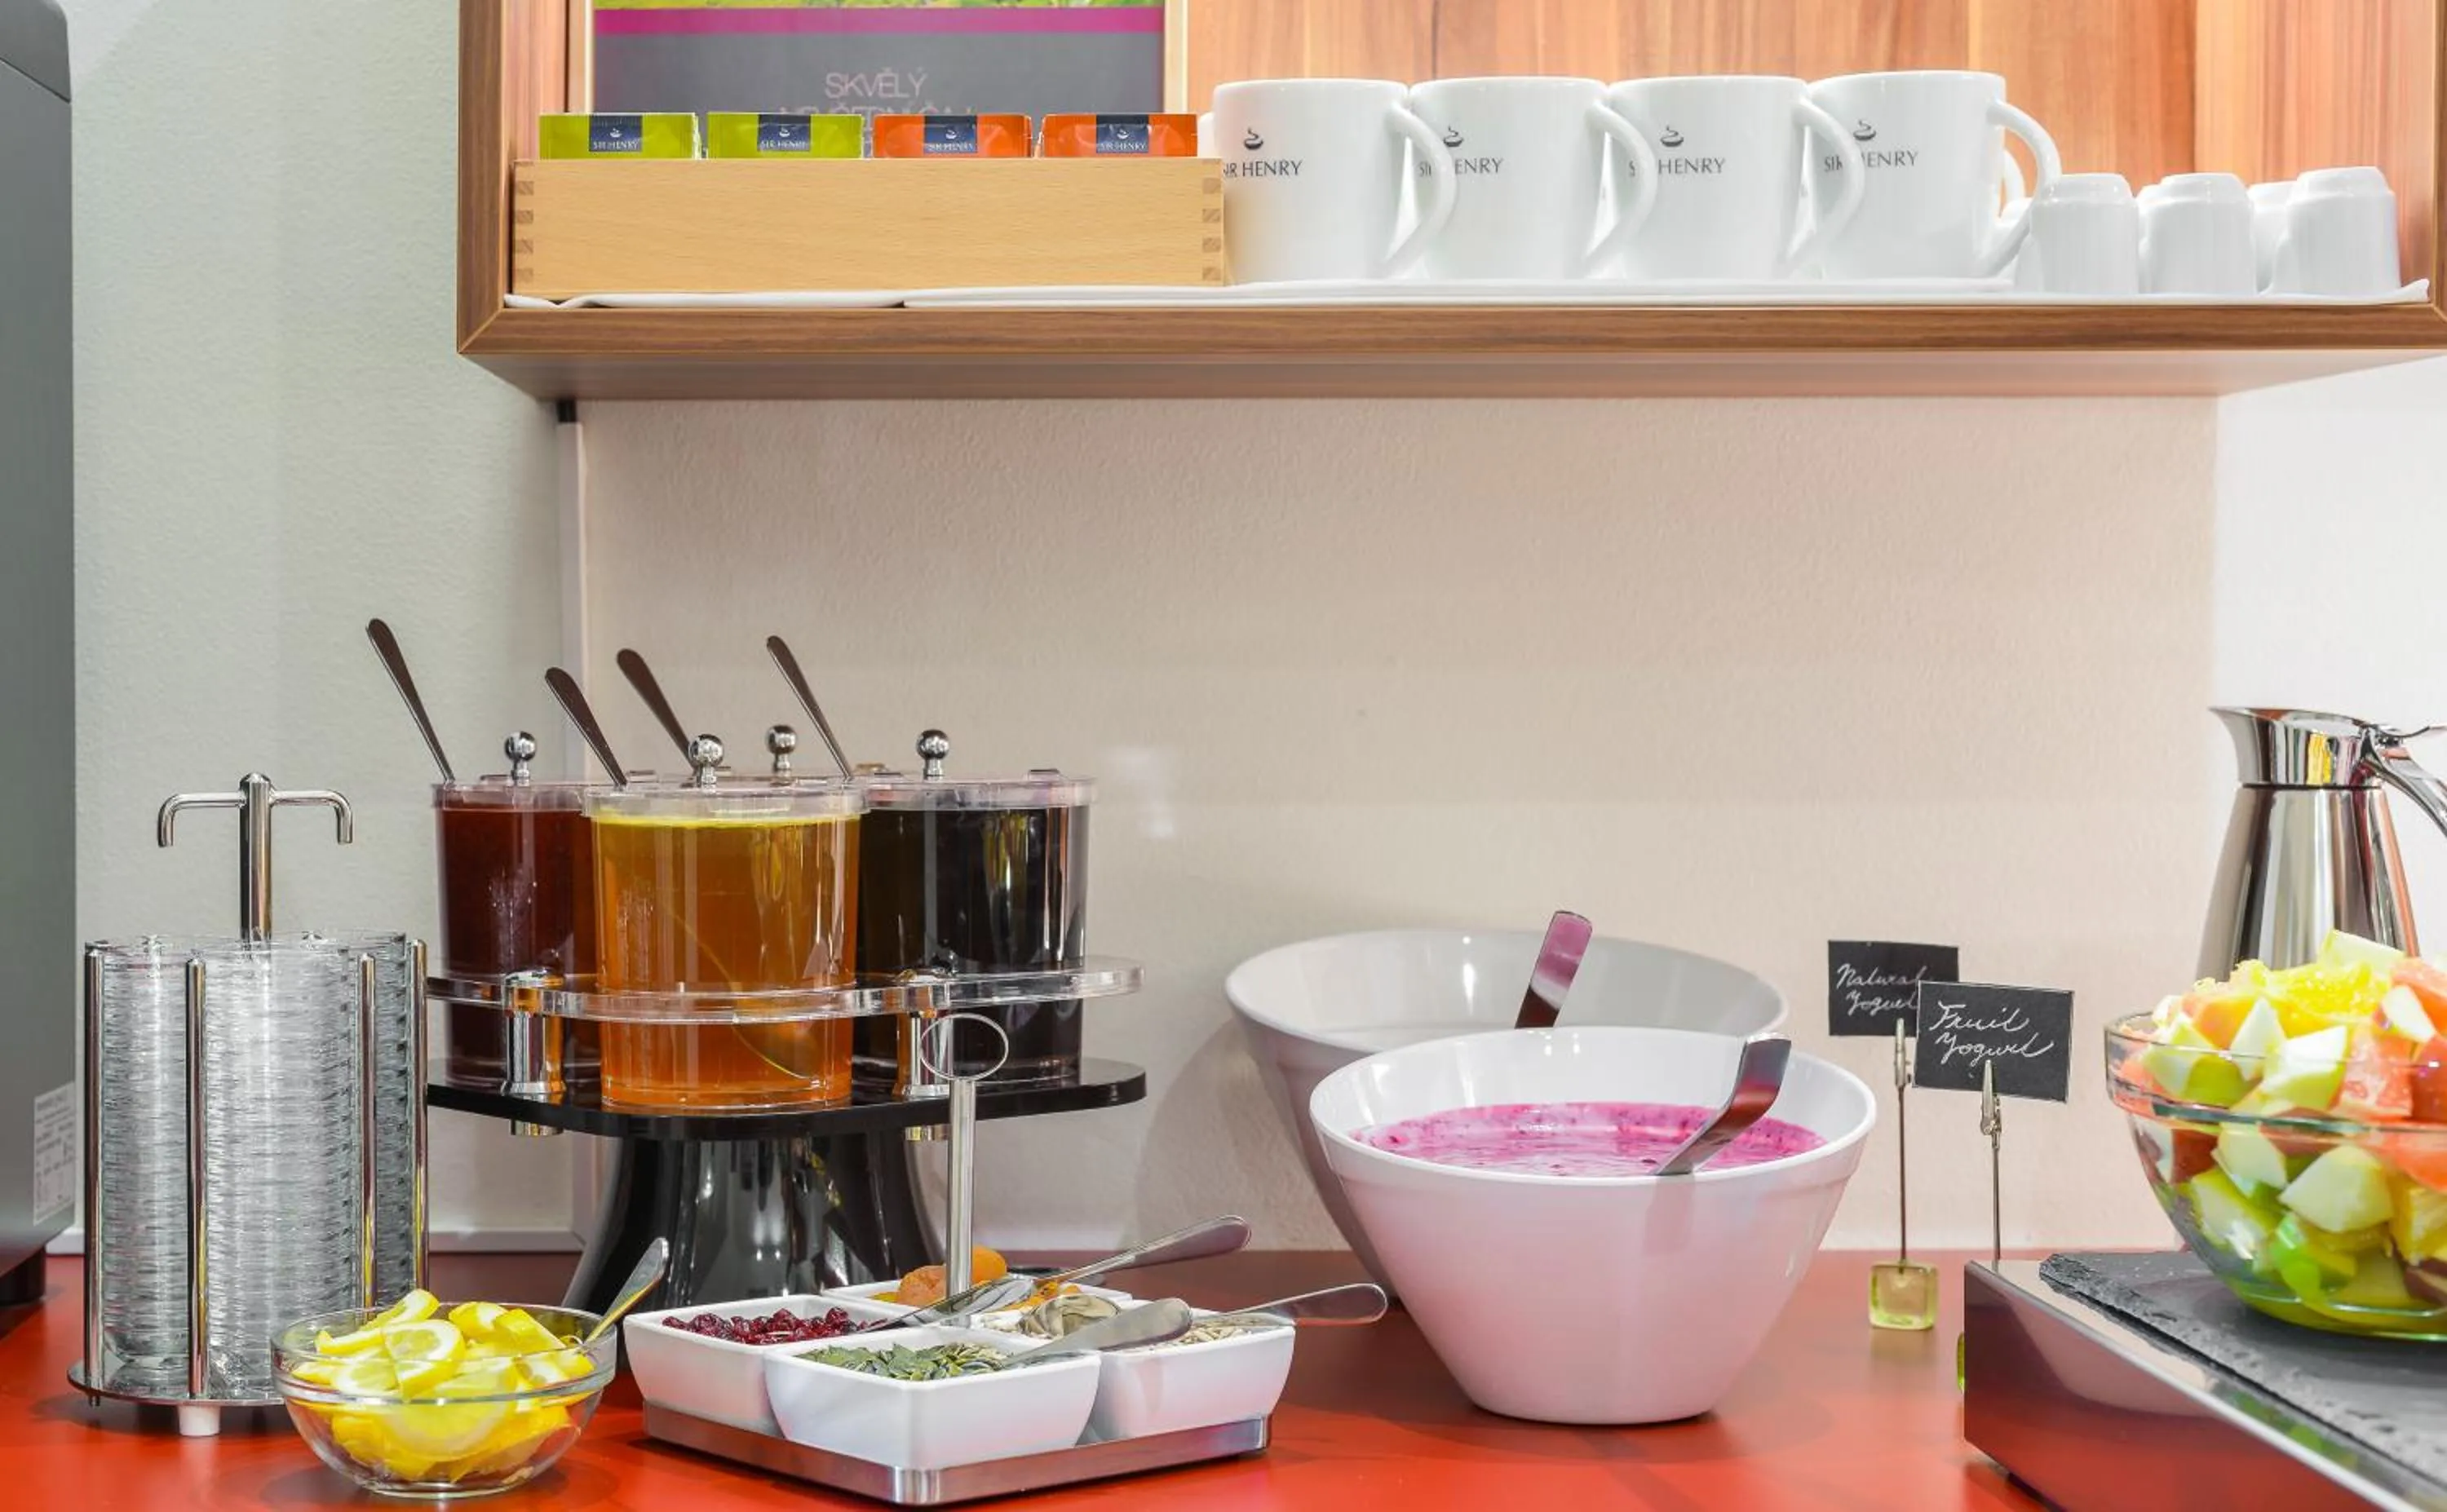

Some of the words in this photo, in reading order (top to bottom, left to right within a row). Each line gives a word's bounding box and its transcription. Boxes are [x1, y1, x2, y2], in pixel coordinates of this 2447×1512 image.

[825, 67, 928, 99] SKVĚLÝ
[1454, 157, 1504, 175] ENRY
[1658, 157, 1726, 175] HENRY
[1861, 150, 1918, 167] ENRY
[1242, 159, 1303, 177] HENRY
[1837, 963, 1927, 989] Natural
[1929, 1000, 2030, 1032] Fruit
